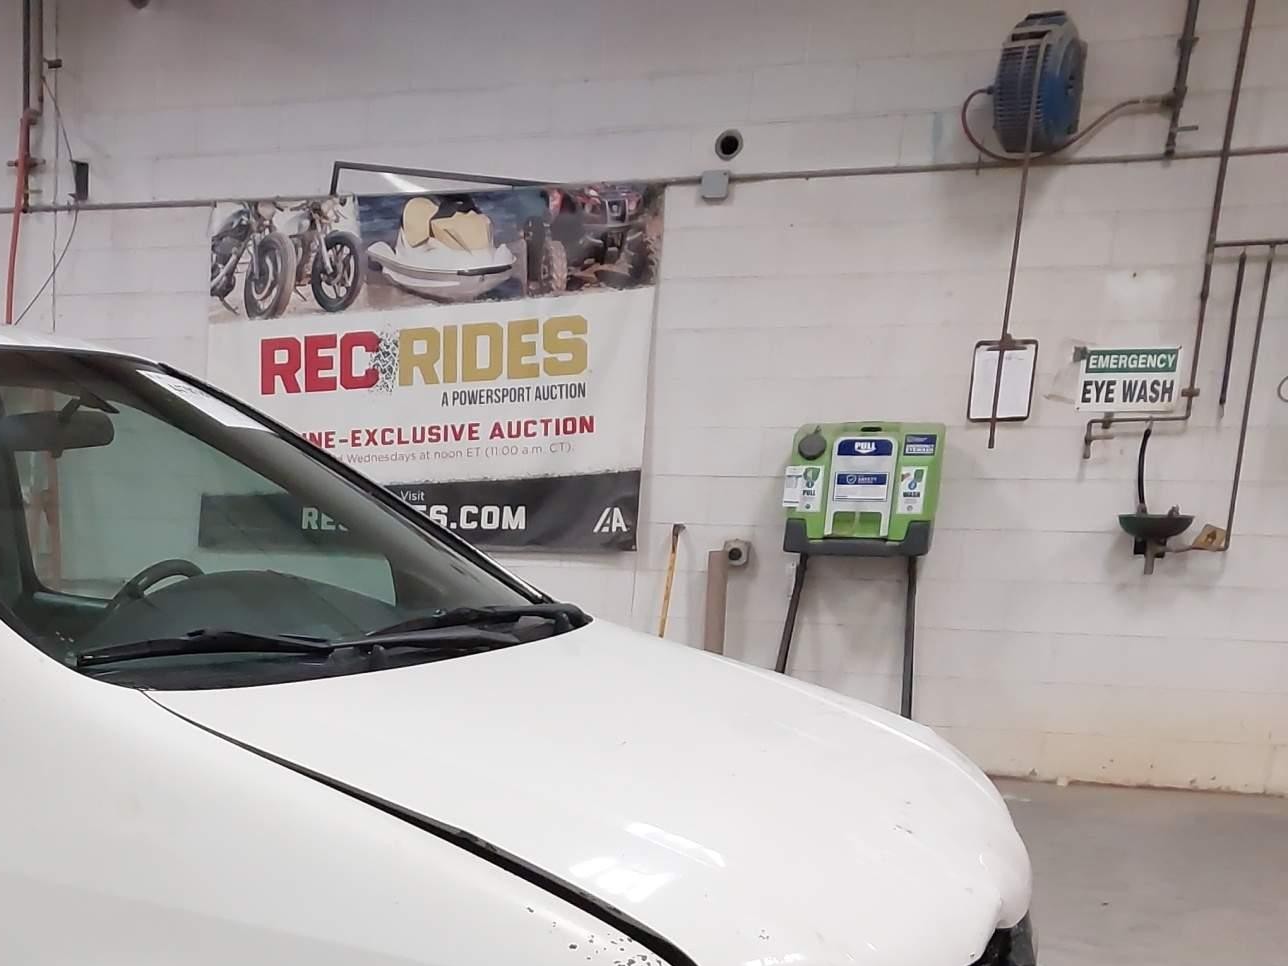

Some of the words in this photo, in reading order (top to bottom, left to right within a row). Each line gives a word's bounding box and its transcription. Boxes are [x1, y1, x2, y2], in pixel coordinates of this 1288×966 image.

[261, 331, 379, 395] REC
[399, 315, 588, 386] RIDES
[1089, 353, 1176, 369] EMERGENCY
[441, 391, 449, 407] A
[452, 386, 532, 406] POWERSPORT
[534, 382, 586, 401] AUCTION
[1081, 380, 1116, 403] EYE
[1122, 379, 1174, 403] WASH
[490, 416, 595, 440] AUCTION
[347, 450, 416, 464] Wednesdays
[420, 450, 430, 460] at
[434, 448, 463, 459] noon
[467, 447, 482, 457] ET
[485, 445, 518, 458] (1100
[522, 443, 544, 455] am
[401, 490, 425, 501] Visit
